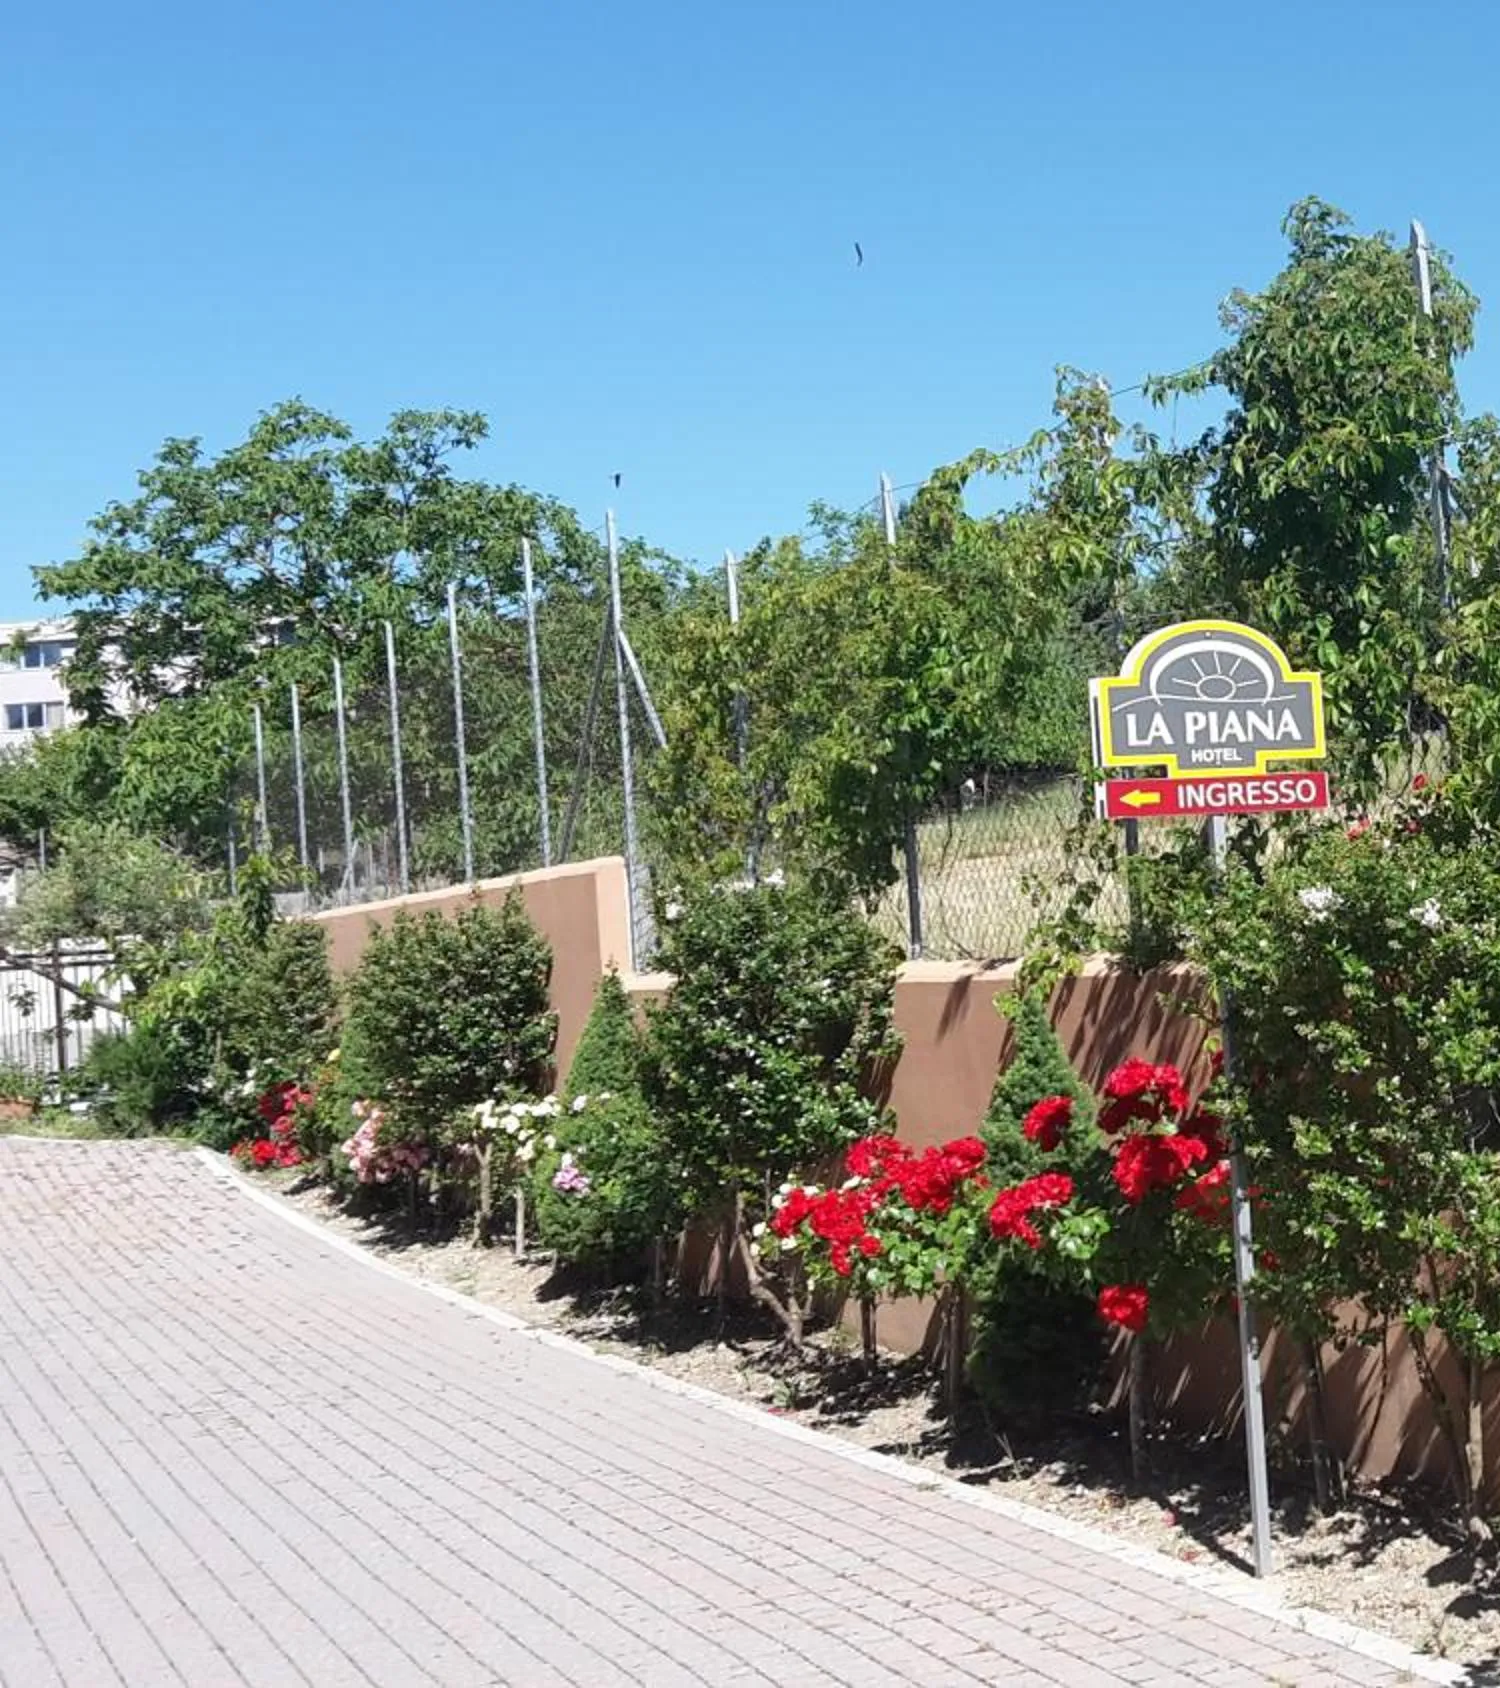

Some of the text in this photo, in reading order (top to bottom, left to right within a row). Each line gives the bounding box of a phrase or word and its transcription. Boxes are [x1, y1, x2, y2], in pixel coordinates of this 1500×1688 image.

[1126, 708, 1302, 746] LA PIANA
[1191, 747, 1243, 763] HOTEL
[1177, 779, 1317, 808] INGRESSO
